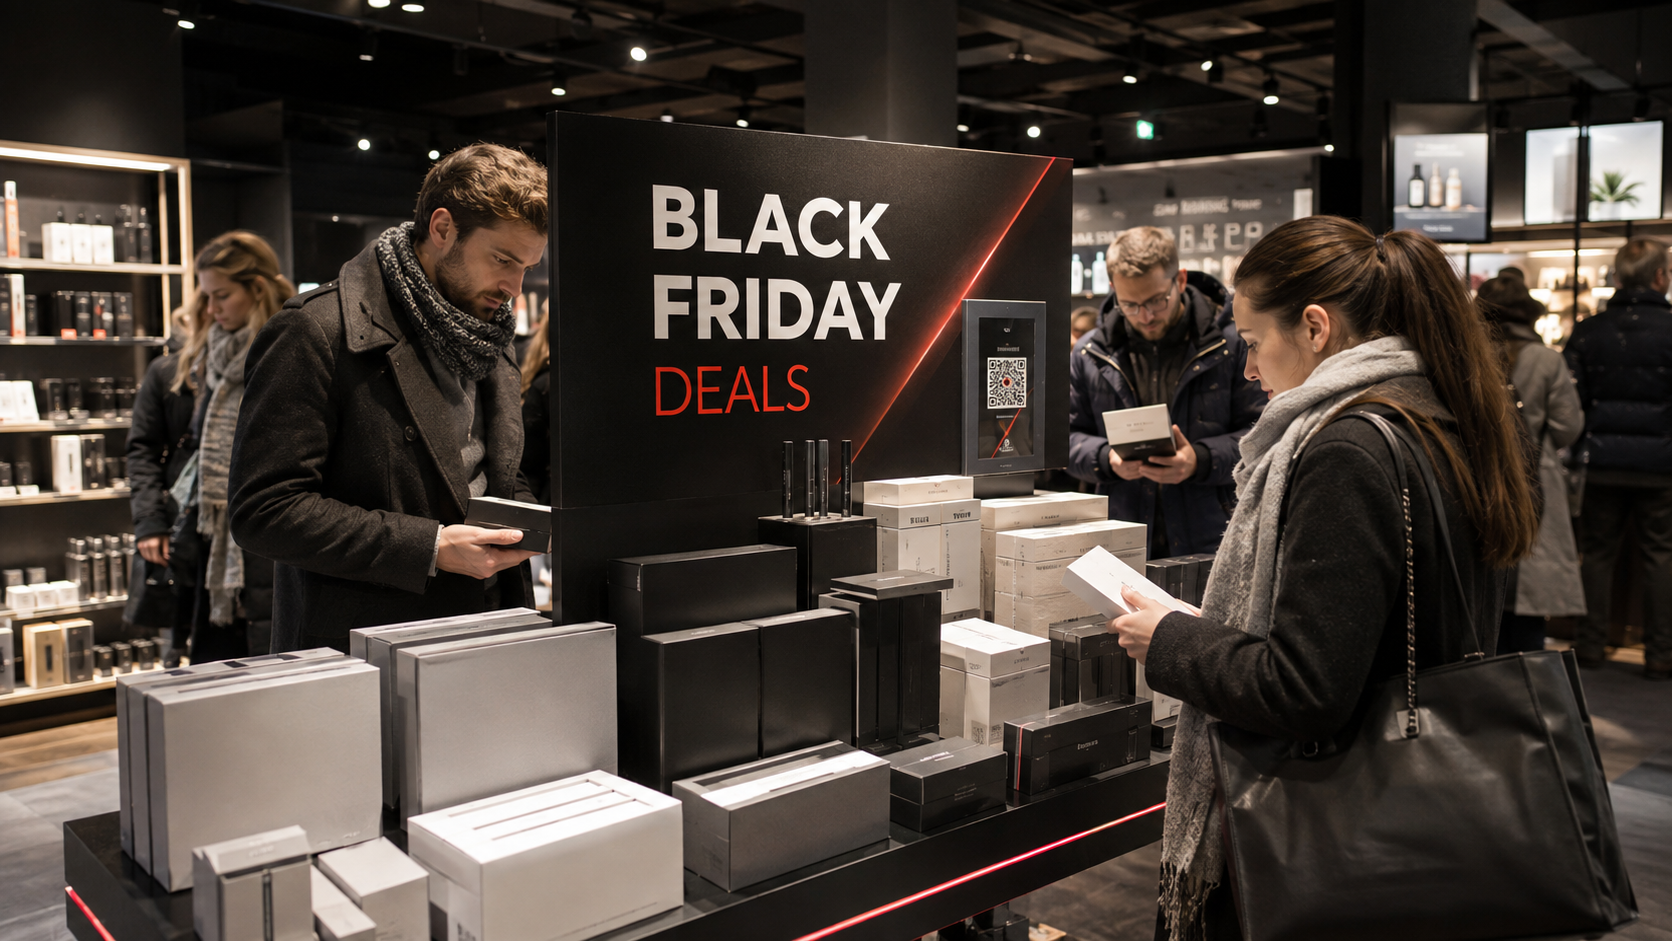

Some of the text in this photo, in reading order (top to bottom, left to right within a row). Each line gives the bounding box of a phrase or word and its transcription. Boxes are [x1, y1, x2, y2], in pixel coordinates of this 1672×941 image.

[652, 184, 891, 261] BLACK
[653, 275, 902, 341] FRIDAY
[655, 364, 811, 416] DEALS
